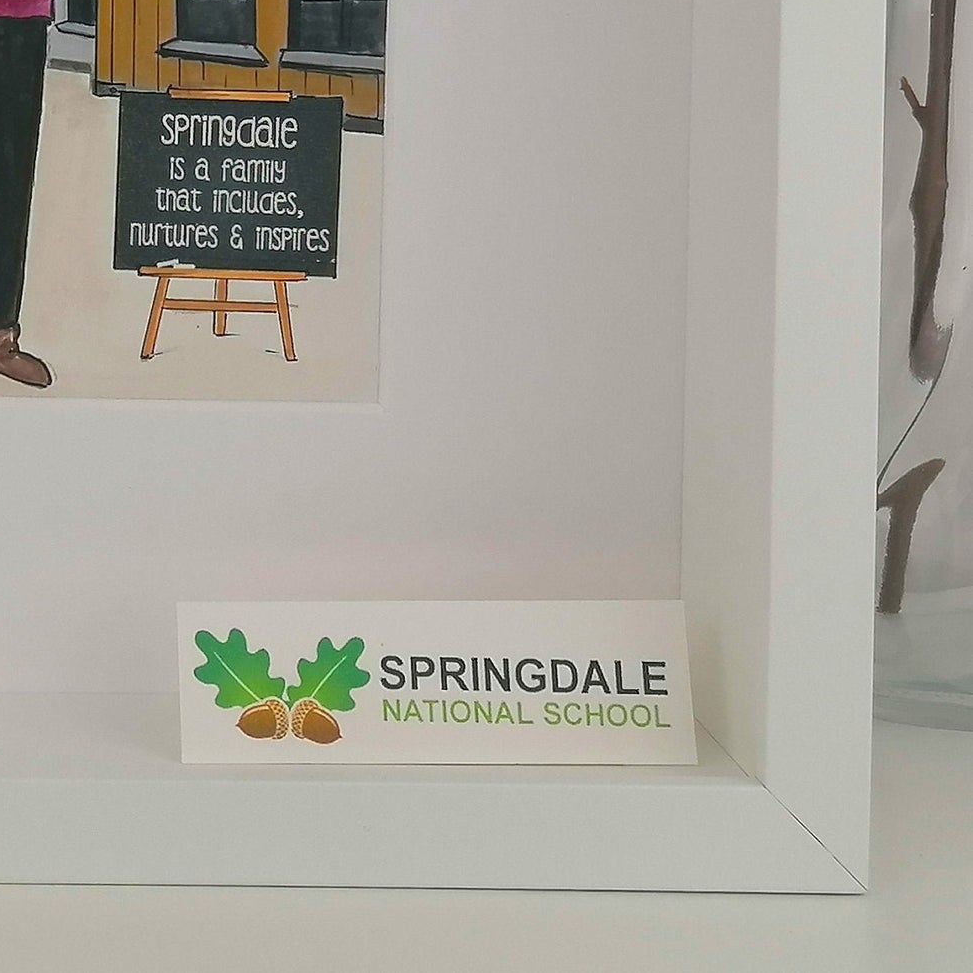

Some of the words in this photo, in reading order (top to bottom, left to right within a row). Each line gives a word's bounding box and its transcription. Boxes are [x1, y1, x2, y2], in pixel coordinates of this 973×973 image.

[169, 156, 185, 181] is
[194, 157, 210, 182] a
[221, 157, 287, 184] family
[155, 186, 203, 212] that
[212, 189, 305, 219] includes,
[129, 222, 219, 249] nurtures
[230, 224, 244, 250] &
[255, 226, 331, 252] inspires
[380, 655, 669, 696] SPRINGDALE
[382, 698, 534, 725] NATIONAL
[543, 701, 672, 728] SCHOOL
